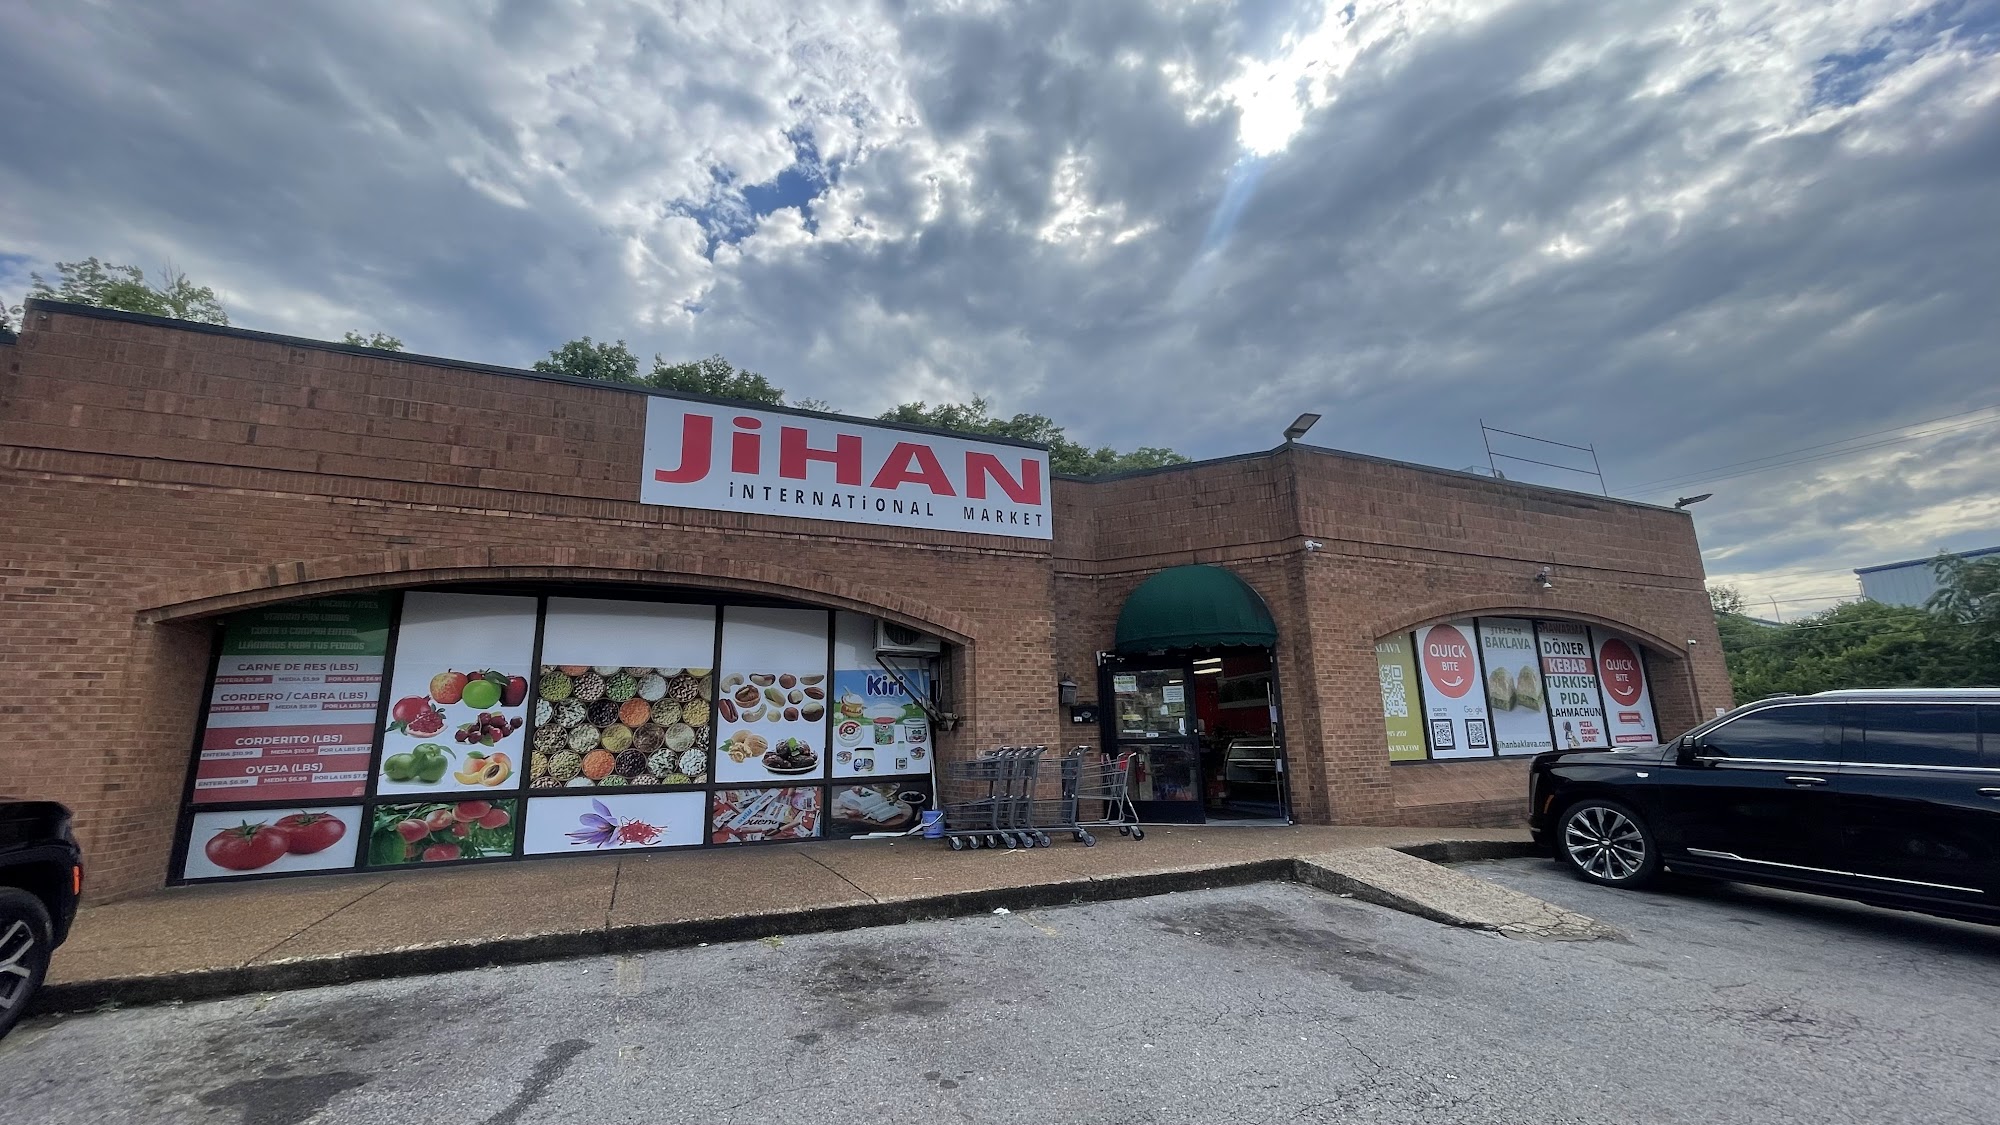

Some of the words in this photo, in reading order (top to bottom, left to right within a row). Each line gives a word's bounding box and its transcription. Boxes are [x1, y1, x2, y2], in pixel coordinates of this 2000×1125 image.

[654, 413, 1042, 506] JiHAN
[963, 505, 1043, 527] MARKET
[1484, 635, 1532, 650] BAKLAVA
[1543, 638, 1586, 656] DÖNER
[1430, 643, 1467, 658] QUICK
[237, 663, 281, 671] CARNE
[284, 663, 300, 671] DE
[303, 663, 327, 671] RES
[329, 662, 359, 672] (LBS)
[1442, 660, 1460, 672] BITE
[1548, 658, 1587, 674] KEBAB
[1605, 658, 1633, 671] QUICK
[1545, 675, 1596, 689] TURKISH
[1615, 672, 1629, 682] BITE
[866, 674, 905, 697] Kiri
[220, 693, 284, 701] CORDERO
[293, 692, 335, 700] CABRA
[338, 691, 368, 701] (LBS)
[1560, 692, 1589, 705] PIDA
[1463, 705, 1483, 715] Gogle
[1551, 707, 1602, 718] LAHMACHUN
[235, 735, 310, 746] CORDERITO
[312, 734, 343, 745] (LBS)
[245, 764, 289, 775] OVEJA
[291, 762, 323, 773] (LBS)
